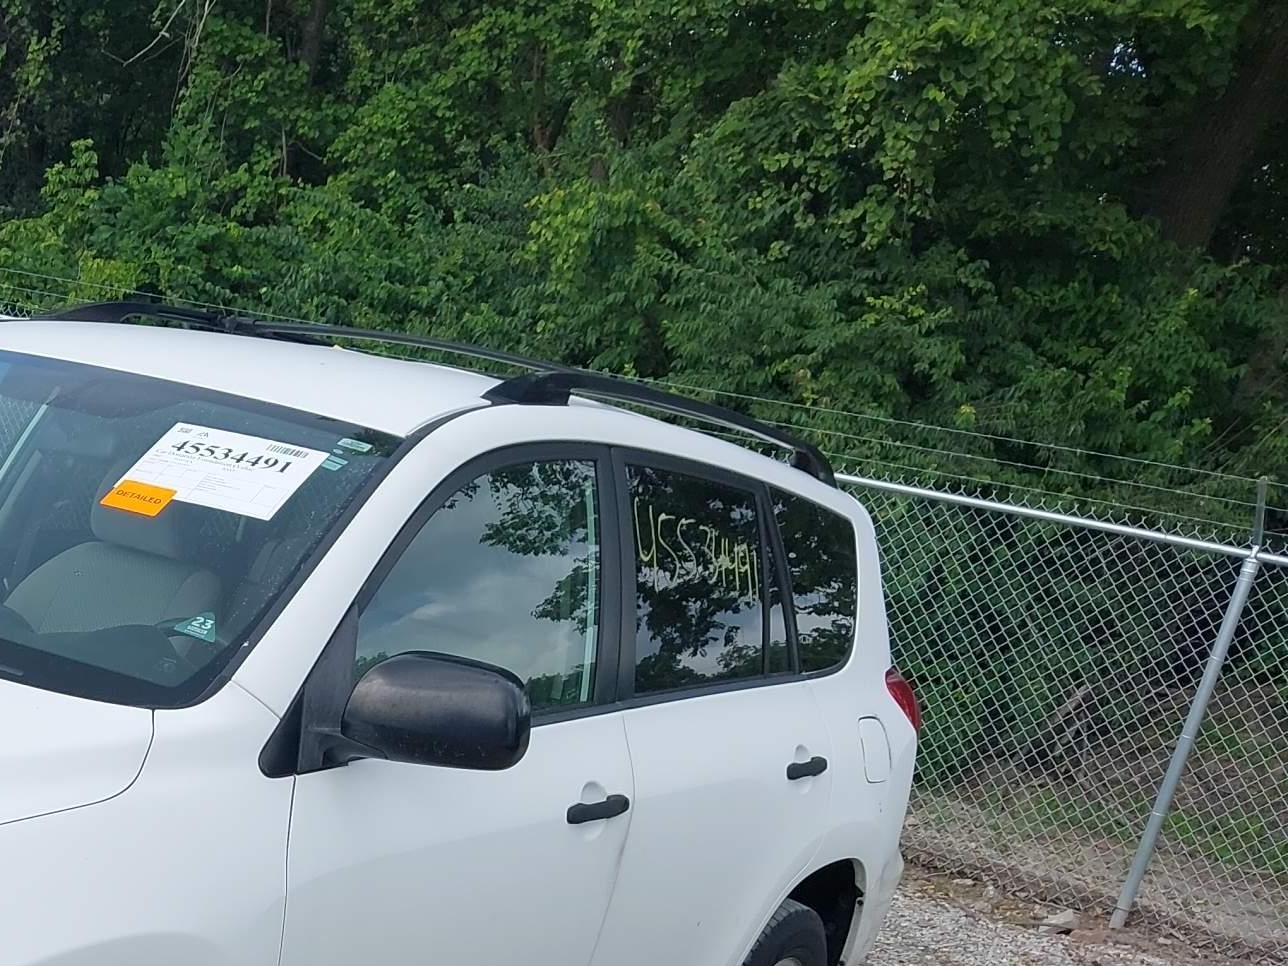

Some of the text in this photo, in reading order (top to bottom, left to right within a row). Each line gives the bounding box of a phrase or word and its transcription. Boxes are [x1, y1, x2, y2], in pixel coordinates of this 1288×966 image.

[171, 440, 293, 474] 45534491
[116, 489, 162, 505] DETAILED
[191, 616, 215, 630] 23
